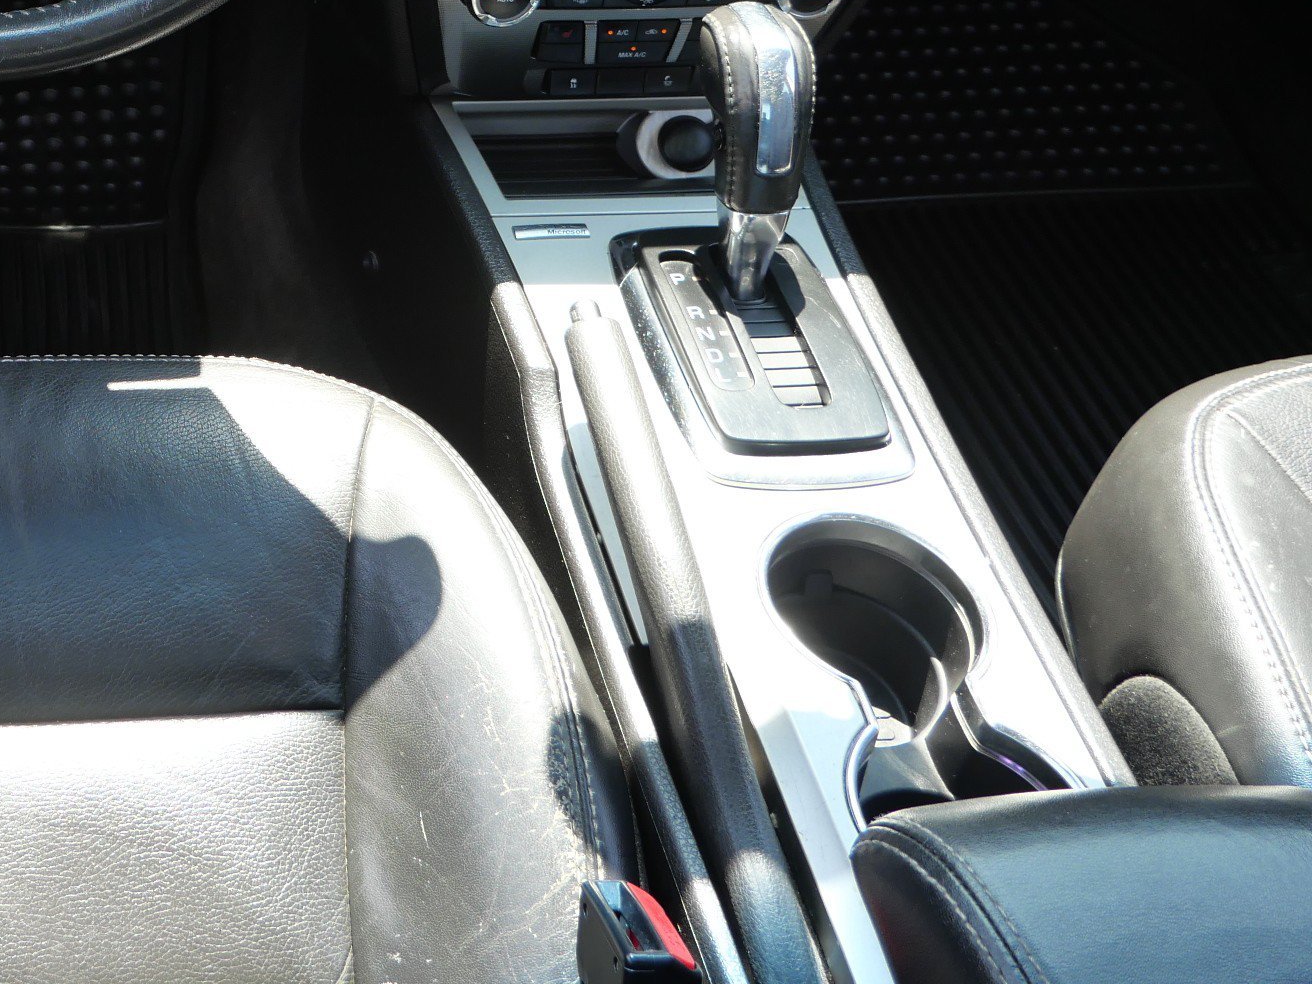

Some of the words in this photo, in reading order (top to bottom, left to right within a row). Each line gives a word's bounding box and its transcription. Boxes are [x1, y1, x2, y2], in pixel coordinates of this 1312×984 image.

[669, 272, 686, 286] P
[686, 306, 706, 320] R
[694, 326, 716, 341] N
[704, 348, 724, 363] D
